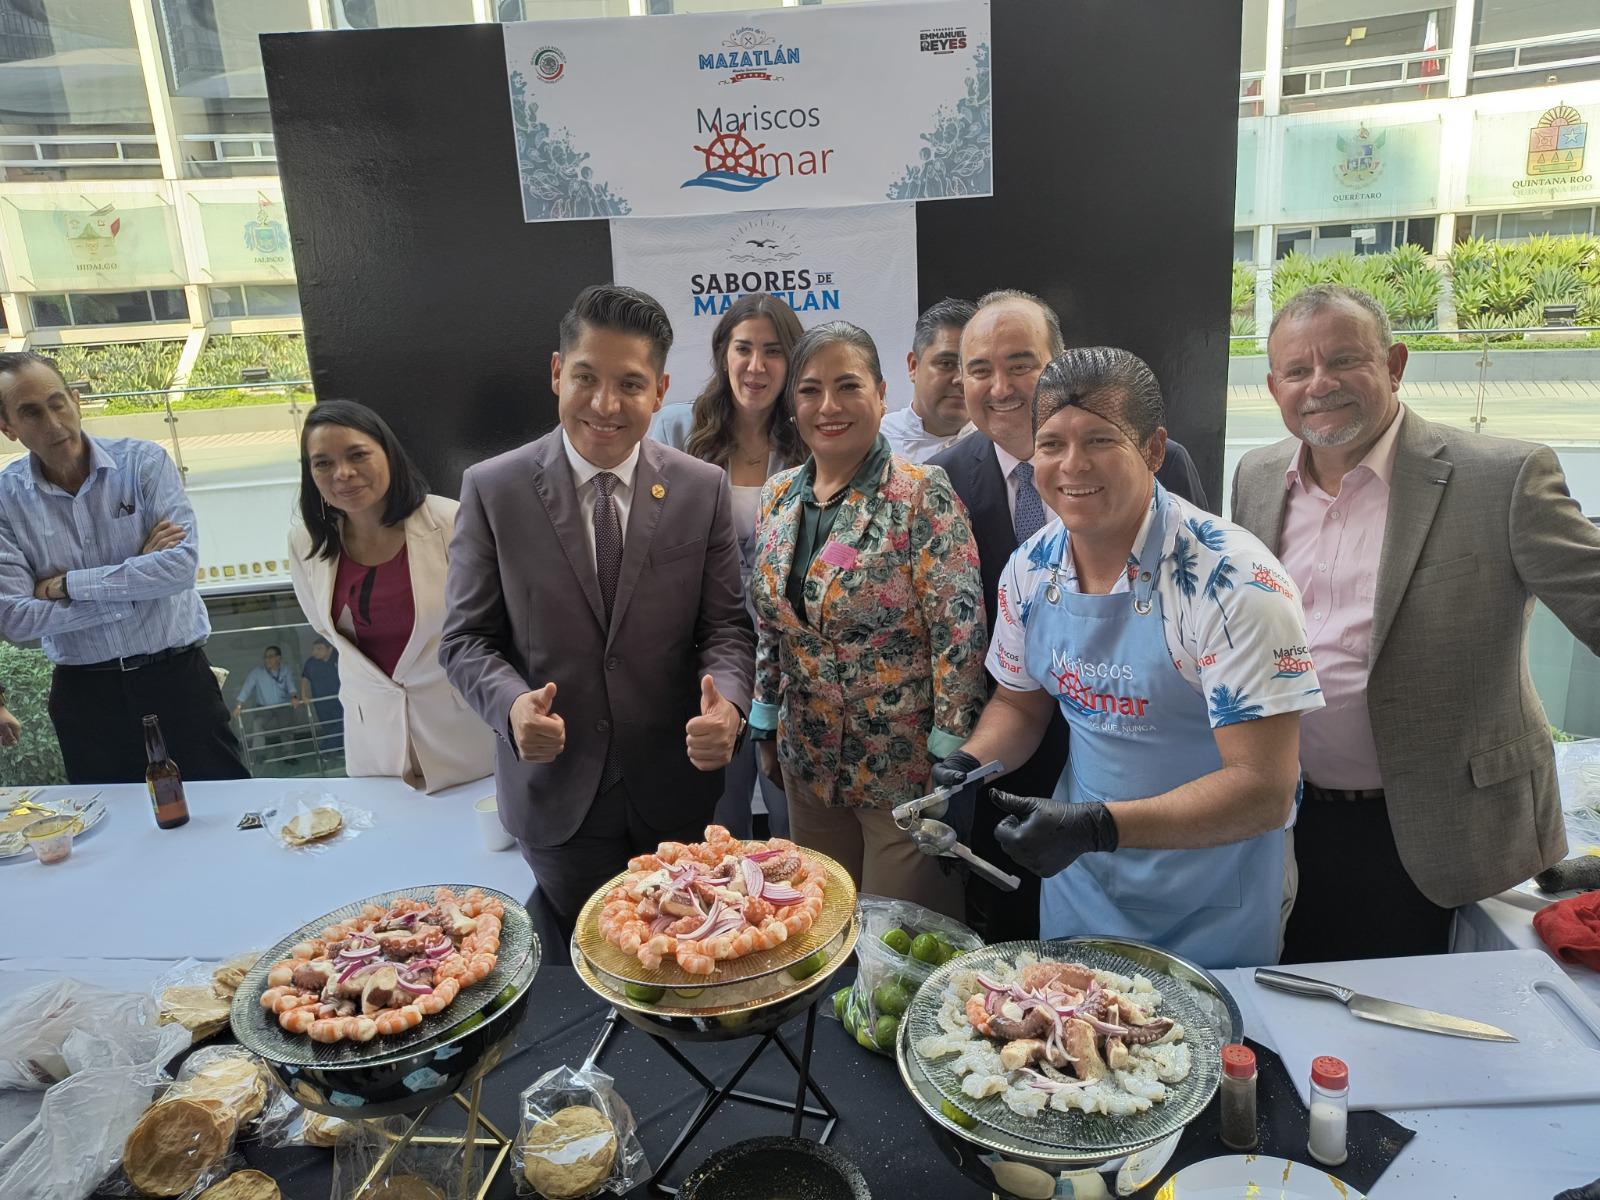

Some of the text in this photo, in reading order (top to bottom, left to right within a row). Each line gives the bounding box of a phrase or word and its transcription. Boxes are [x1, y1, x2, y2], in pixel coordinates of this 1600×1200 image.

[920, 30, 967, 41] EMMANUEL
[920, 37, 967, 52] REYES
[698, 44, 801, 70] MAZATLÁN
[697, 105, 821, 134] Mariscos
[1512, 175, 1593, 189] QUINTANA ROO
[1333, 191, 1382, 202] QUERÉTARO
[76, 262, 117, 272] HIDALGO
[254, 256, 284, 264] JALISCO
[691, 269, 832, 295] SABORES DE
[694, 289, 840, 316] MALAN
[1052, 648, 1134, 680] Mariscos
